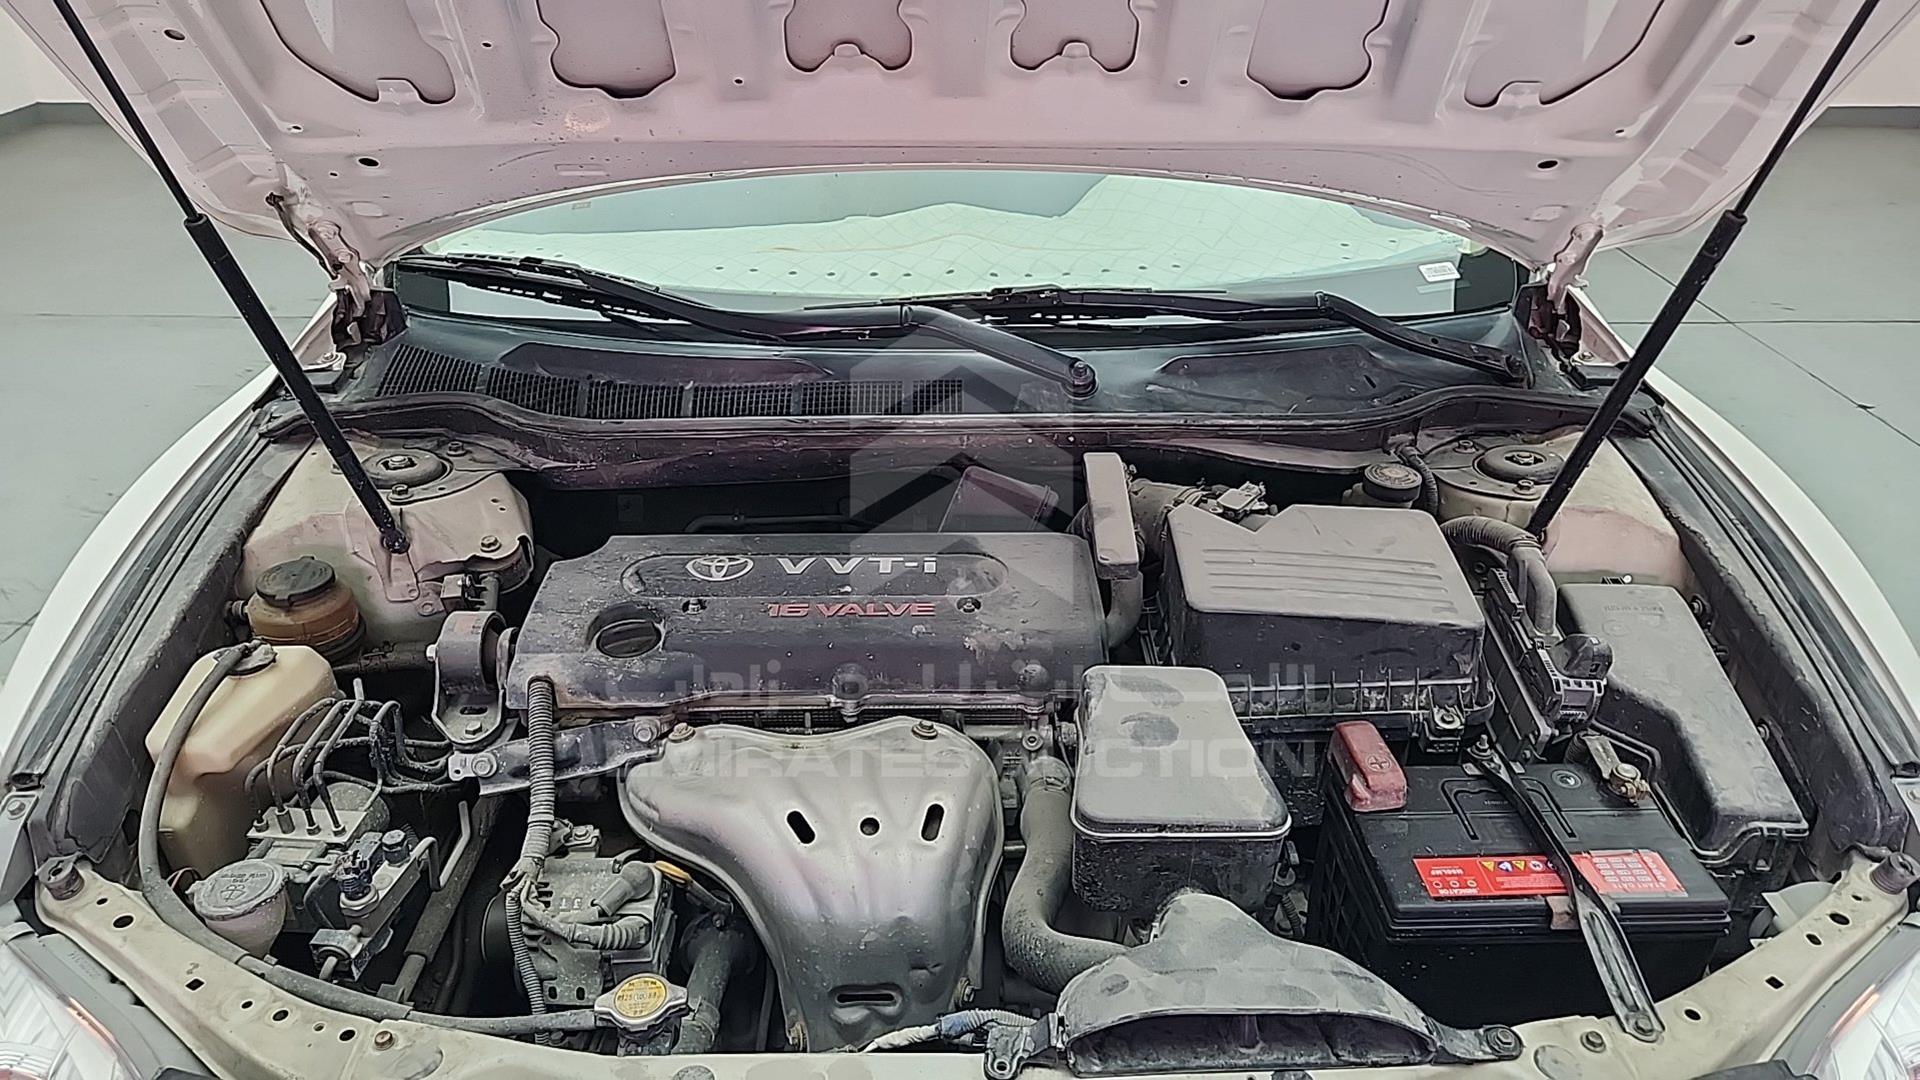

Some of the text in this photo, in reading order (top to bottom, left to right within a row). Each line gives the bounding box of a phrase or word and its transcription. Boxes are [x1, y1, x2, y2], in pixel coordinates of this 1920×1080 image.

[776, 557, 938, 575] VVT-i
[767, 603, 937, 618] 16 VALVE
